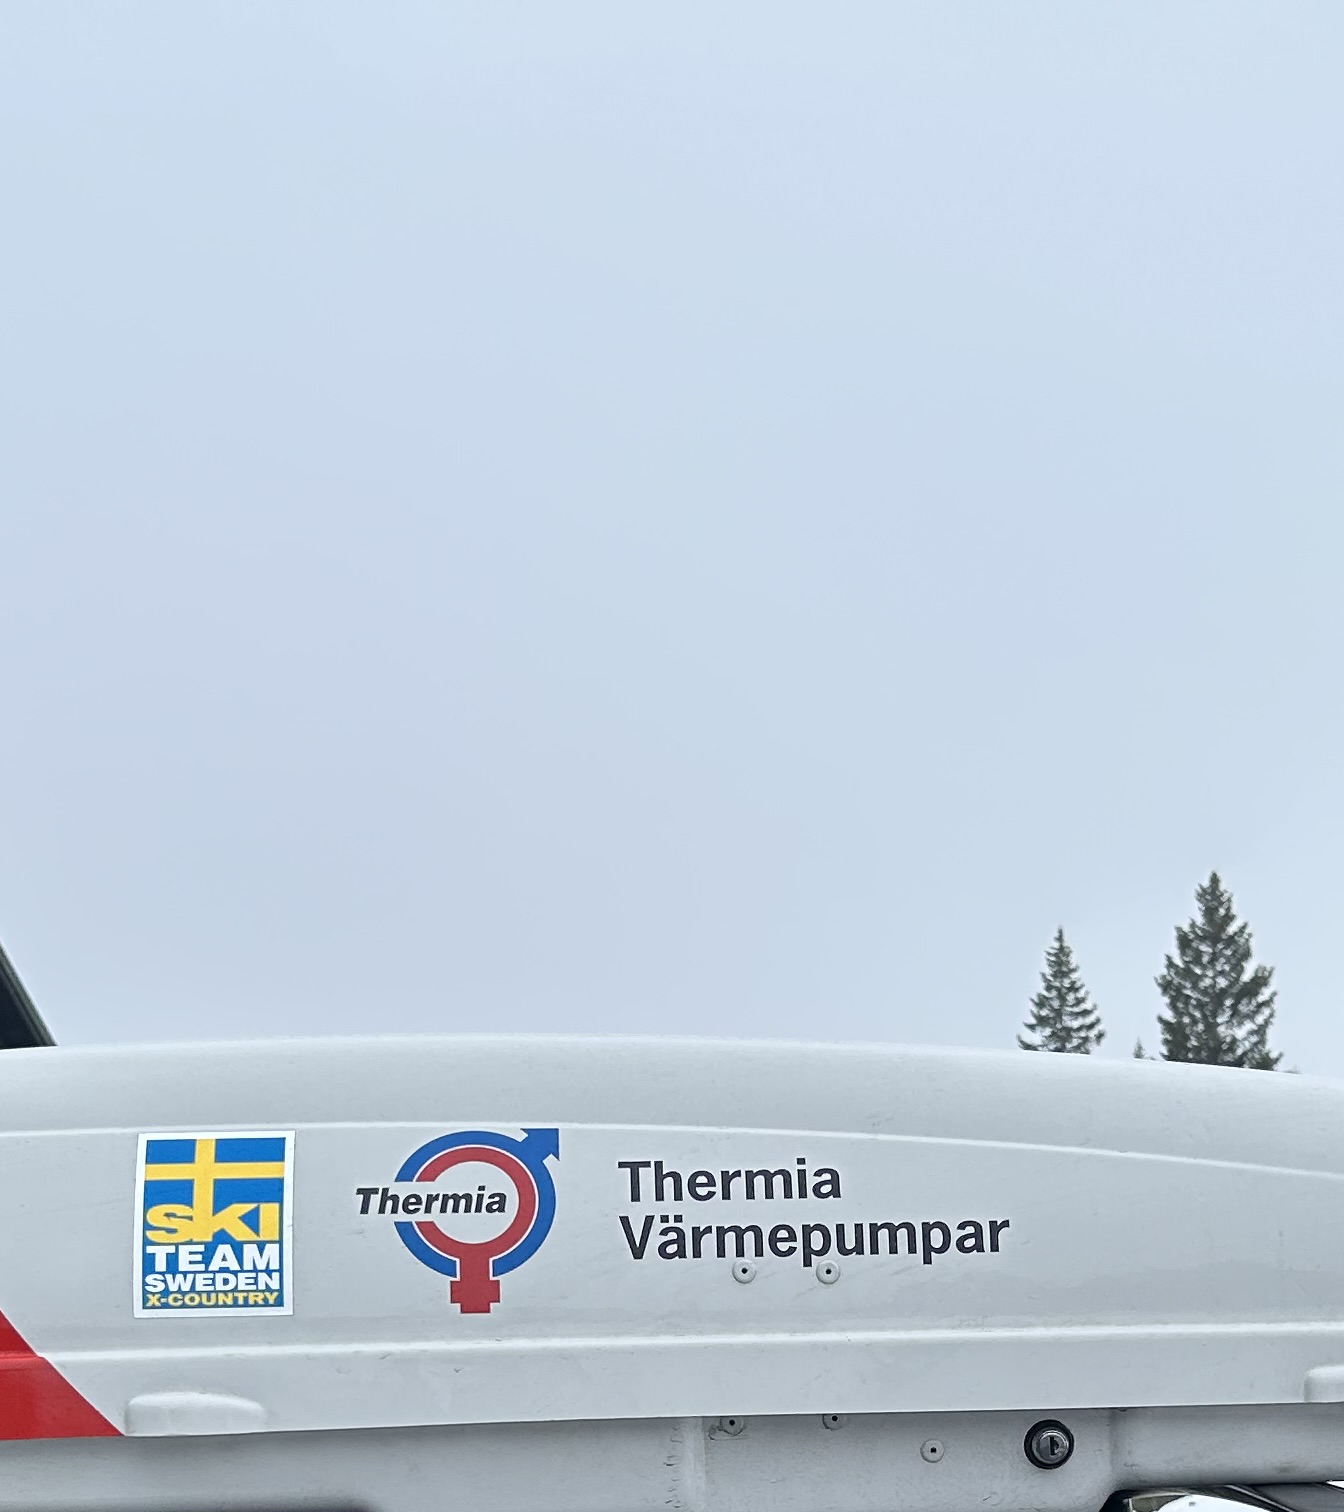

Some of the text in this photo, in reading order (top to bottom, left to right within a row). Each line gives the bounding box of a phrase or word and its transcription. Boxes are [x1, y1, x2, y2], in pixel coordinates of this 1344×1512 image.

[618, 1158, 842, 1202] Thermia
[356, 1185, 507, 1214] Thermia
[146, 1203, 280, 1243] SKI
[619, 1215, 1010, 1267] Värmepumpar
[146, 1244, 280, 1272] TEAM
[145, 1272, 280, 1293] SWEDEN
[146, 1291, 279, 1307] X-COUNTRY
